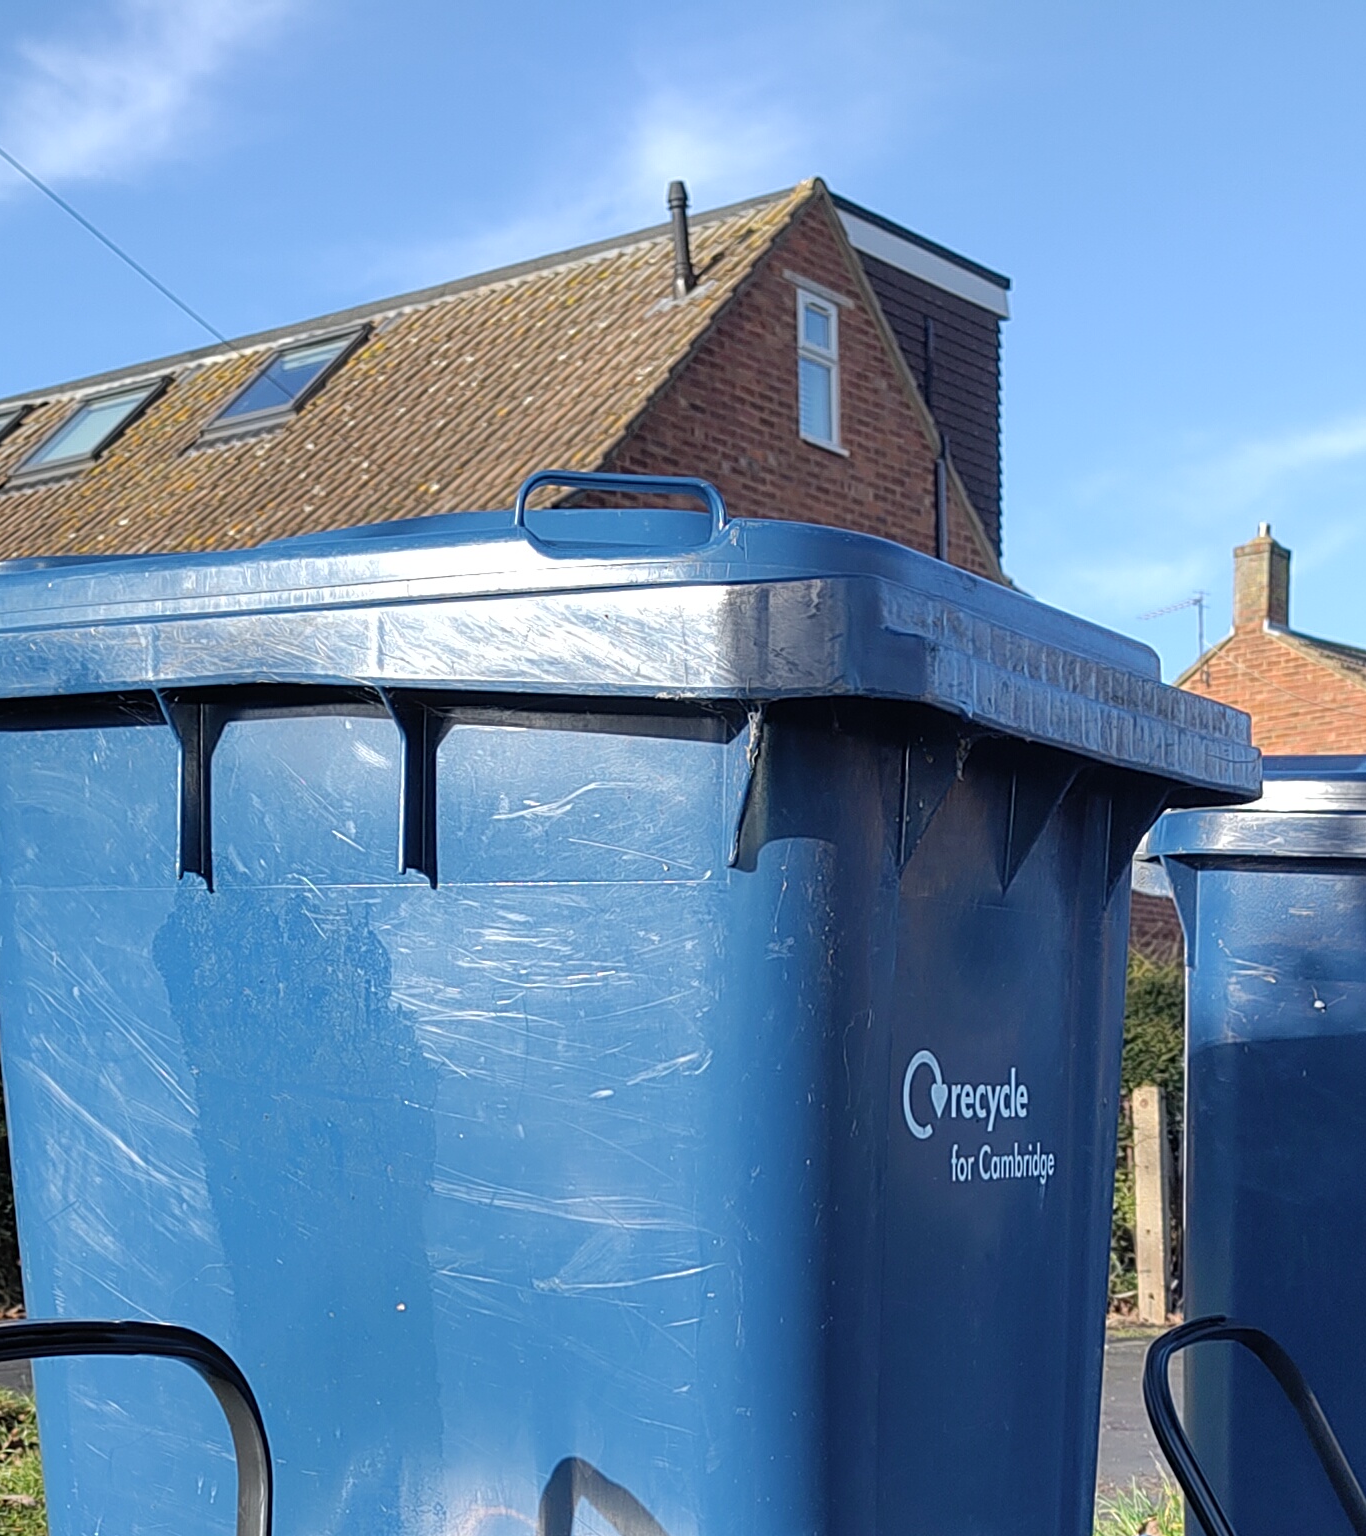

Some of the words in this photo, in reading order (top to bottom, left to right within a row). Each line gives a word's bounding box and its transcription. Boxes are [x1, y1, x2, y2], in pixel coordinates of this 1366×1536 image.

[951, 1067, 1029, 1132] recycle
[951, 1144, 975, 1182] for
[979, 1142, 1055, 1185] Cambridge
